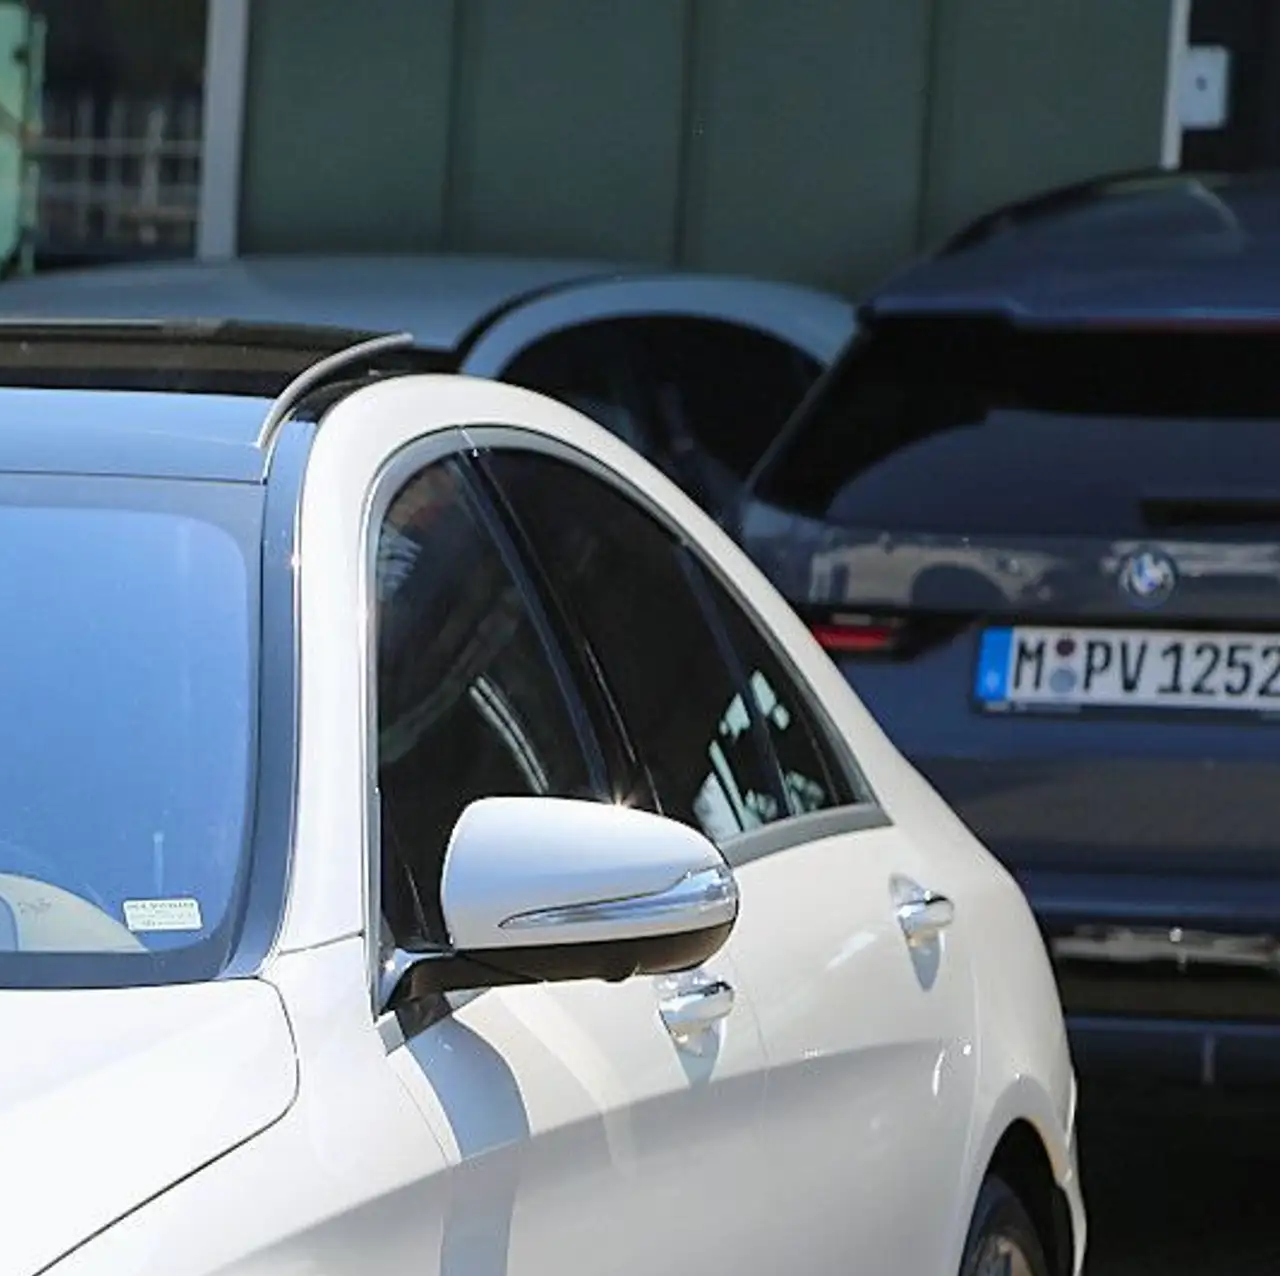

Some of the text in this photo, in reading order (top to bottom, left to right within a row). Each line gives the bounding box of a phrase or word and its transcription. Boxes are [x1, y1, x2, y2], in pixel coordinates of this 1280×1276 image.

[1013, 640, 1280, 694] M PV 1252
